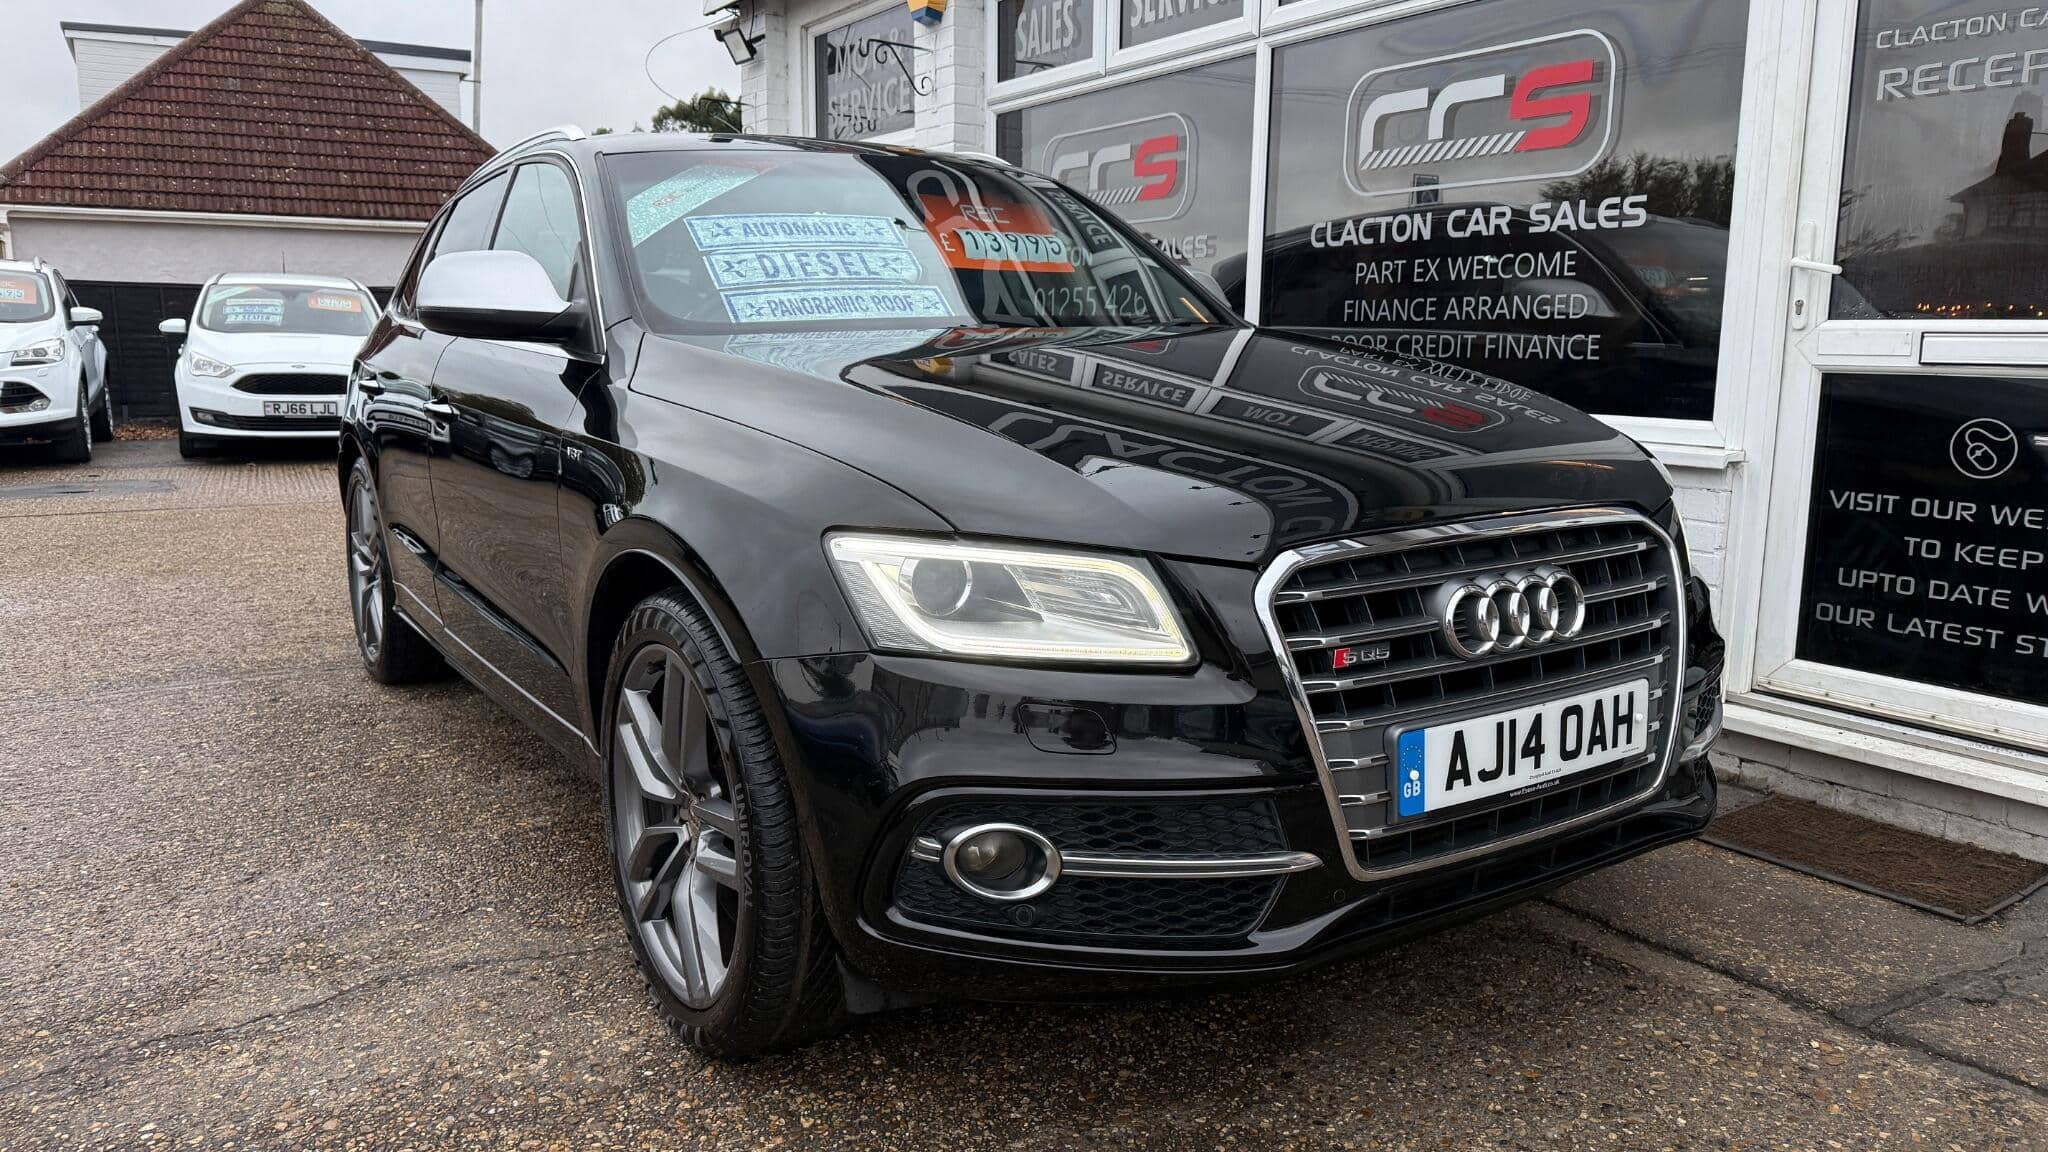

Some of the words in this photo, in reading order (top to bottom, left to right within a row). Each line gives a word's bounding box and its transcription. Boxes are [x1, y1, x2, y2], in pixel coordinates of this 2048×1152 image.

[1016, 0, 1073, 60] SALES
[1876, 12, 2007, 49] CLACTON
[828, 78, 911, 129] SERVICE
[1359, 58, 1594, 170] CCS
[742, 221, 855, 239] AUTOMATIC
[1311, 211, 1432, 249] CLACTON
[1447, 207, 1511, 239] CAR
[1529, 194, 1648, 233] SALES
[940, 232, 956, 252] £
[963, 230, 1063, 256] 13995
[1150, 233, 1208, 259] ALES
[757, 251, 881, 279] DIESEL
[1355, 259, 1406, 285] PART
[1414, 258, 1440, 282] EX
[1448, 250, 1577, 281] WELCOME
[766, 295, 871, 317] PANORAMIC
[873, 294, 914, 312] ROOF
[1034, 286, 1097, 316] 01255
[1343, 297, 1436, 322] FINANCE
[1444, 293, 1588, 321] ARRANGED
[1396, 335, 1476, 360] CREDIT
[1484, 334, 1600, 360] FINANCE
[273, 404, 306, 414] RJ66
[310, 404, 335, 414] LJL
[1829, 489, 1899, 514] VISIT
[1910, 498, 1977, 522] OUR
[1991, 505, 2048, 529] WE
[1904, 536, 1941, 559] TO
[1954, 542, 2044, 570] KEEP
[1838, 567, 1915, 595] UPTO
[1928, 580, 2012, 609] DATE
[1816, 602, 1875, 629] OUR
[1887, 613, 2004, 649] LATEST
[1445, 713, 1545, 791] AJ14
[1560, 691, 1635, 762] OAH
[1404, 782, 1421, 798] GB
[734, 783, 753, 910] UNIROYAL
